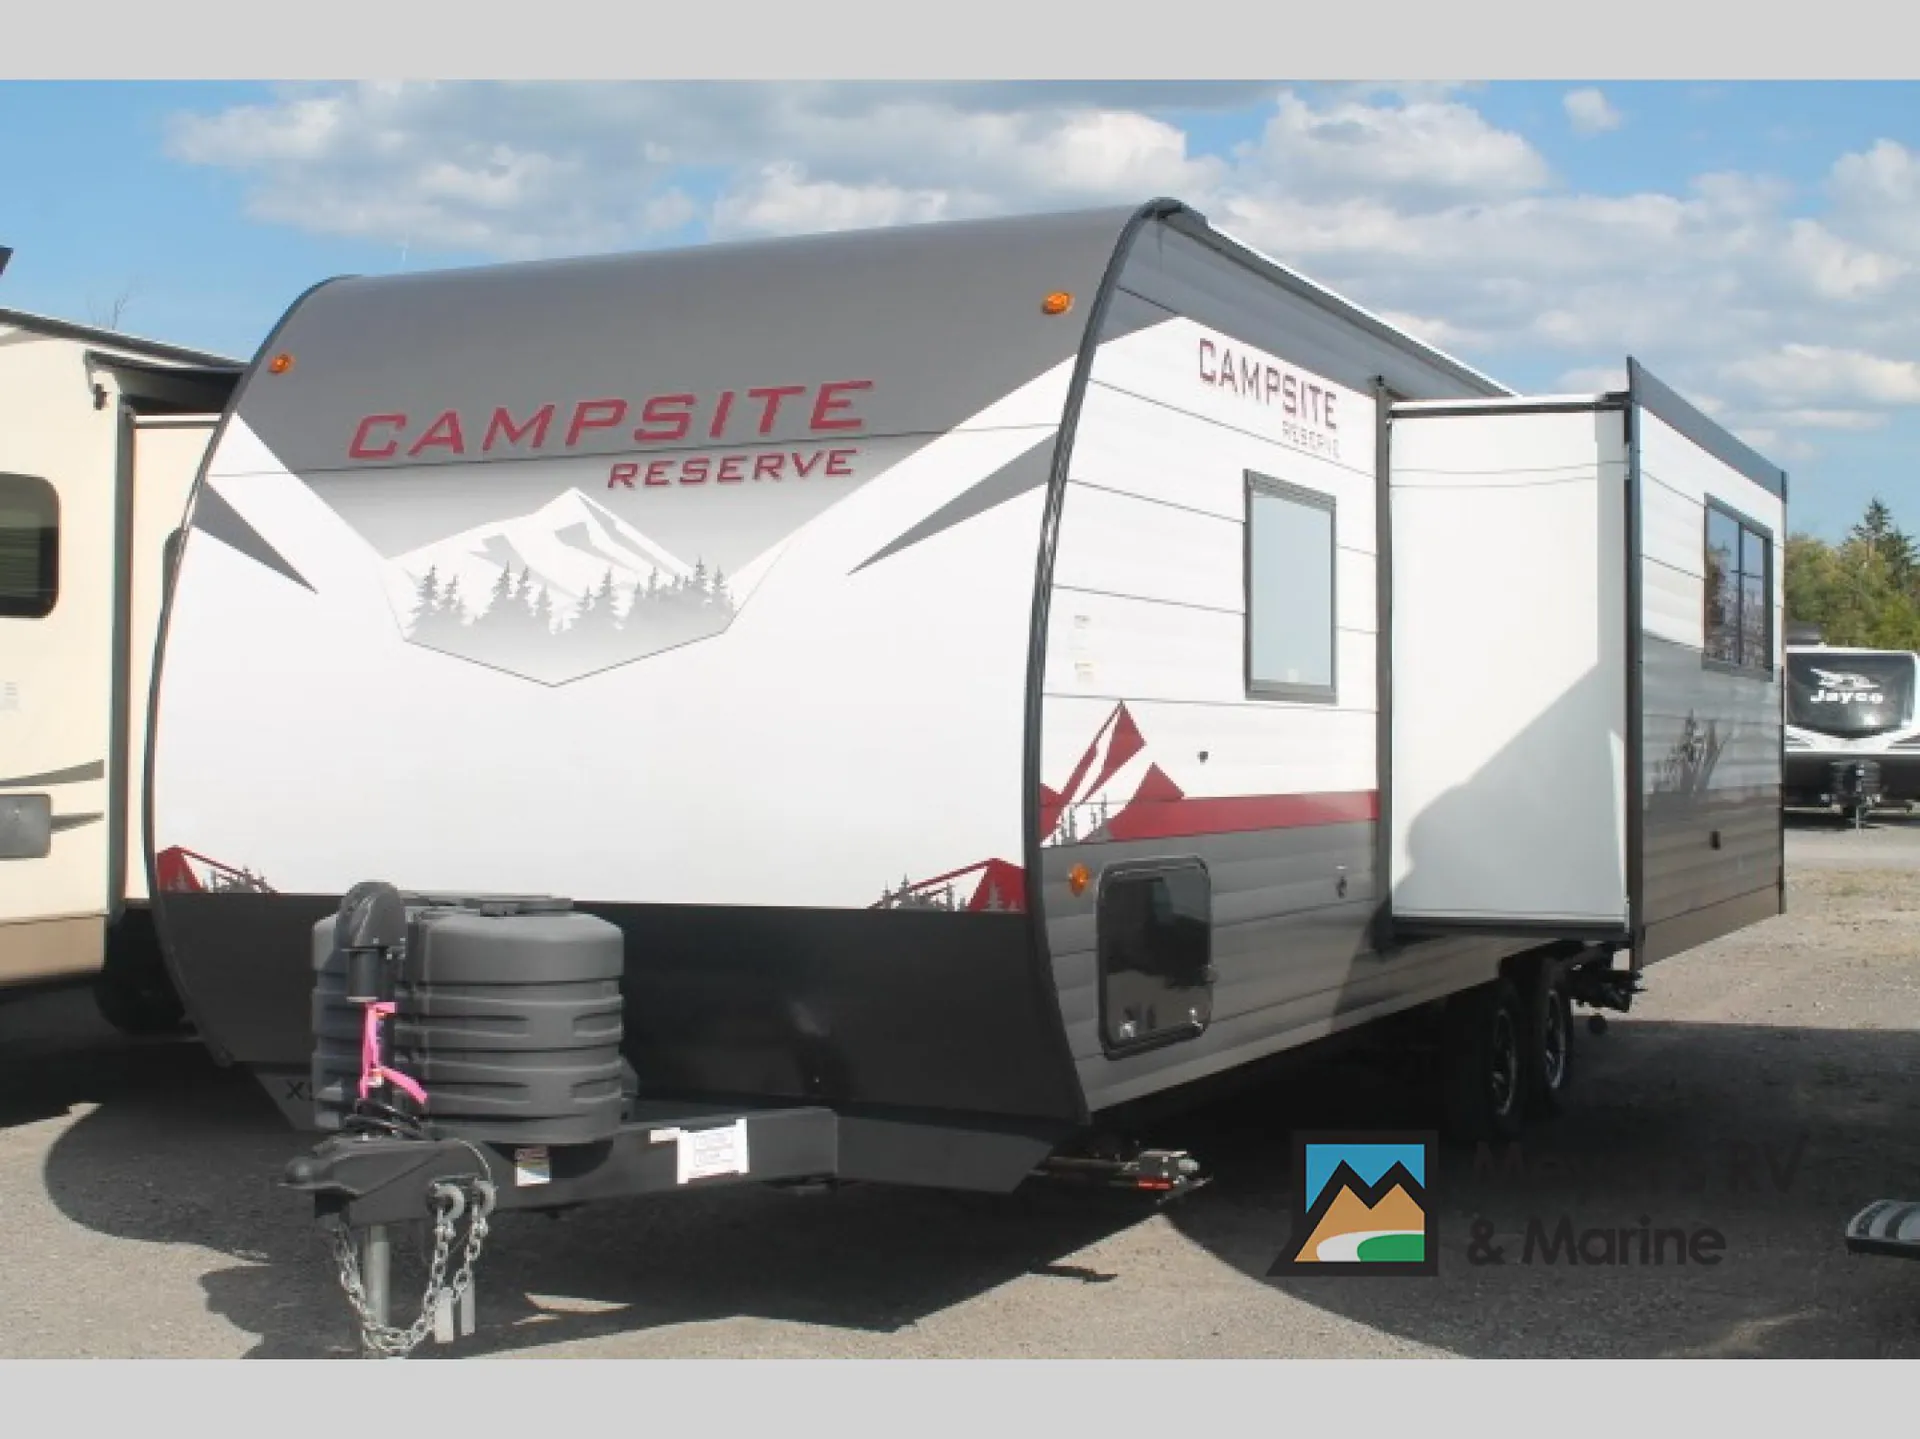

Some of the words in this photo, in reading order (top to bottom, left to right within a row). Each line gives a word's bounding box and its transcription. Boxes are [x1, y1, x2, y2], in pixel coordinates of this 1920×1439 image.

[1199, 337, 1337, 430] CAMPSITE
[348, 380, 874, 459] CAMPSITE
[607, 448, 859, 489] RESERVE
[1810, 689, 1884, 705] Jayco
